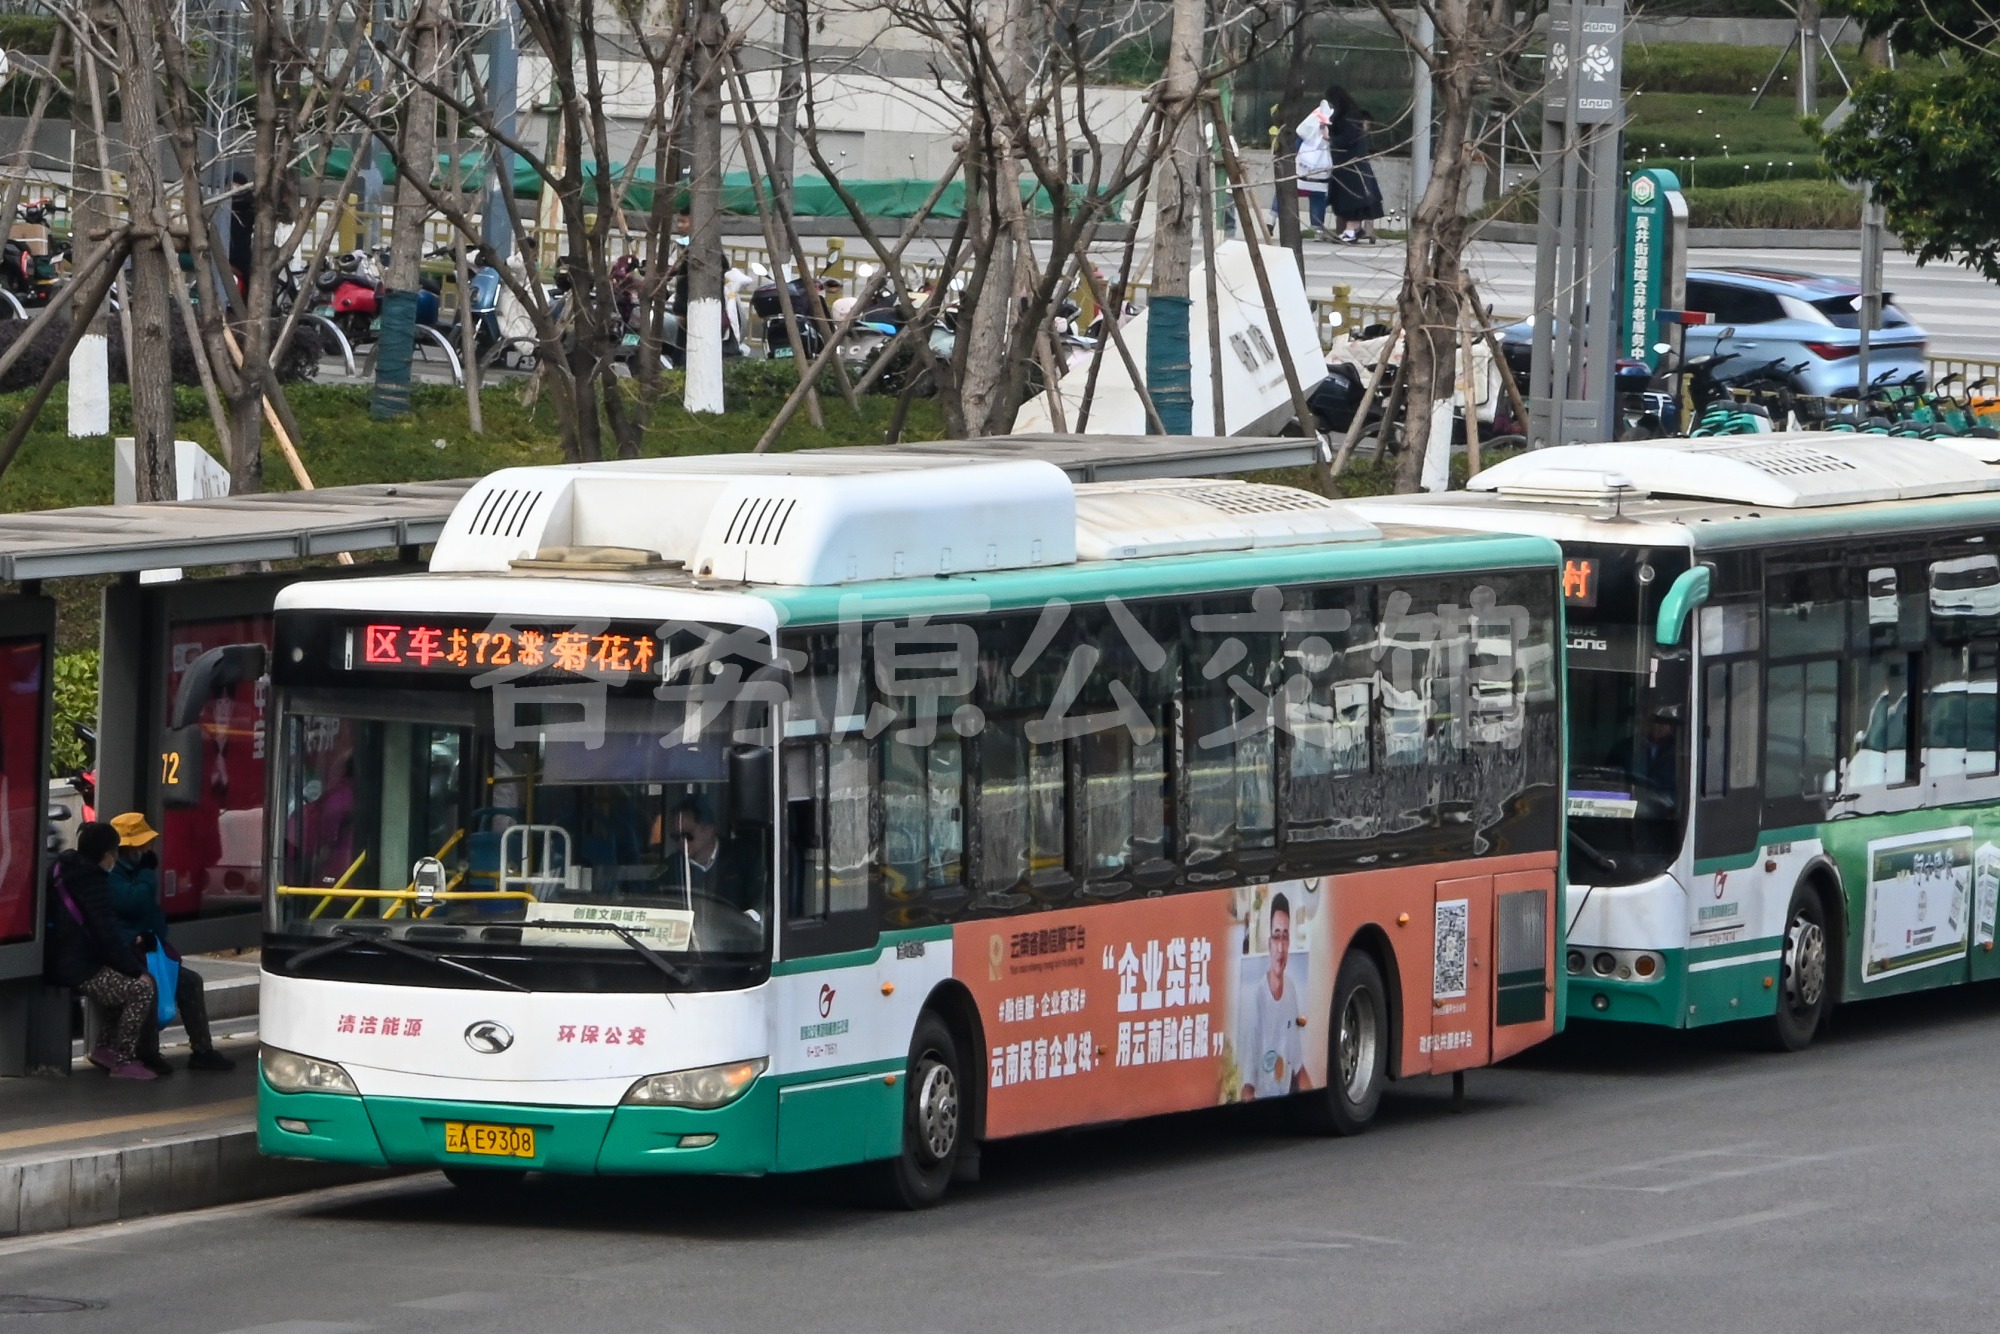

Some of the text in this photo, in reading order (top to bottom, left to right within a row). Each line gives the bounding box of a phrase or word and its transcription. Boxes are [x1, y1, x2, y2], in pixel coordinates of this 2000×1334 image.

[1563, 560, 1591, 598] 村
[573, 906, 647, 922] 创建文明城市
[337, 1015, 423, 1037] 清洁能源
[557, 1025, 647, 1046] 环保公交
